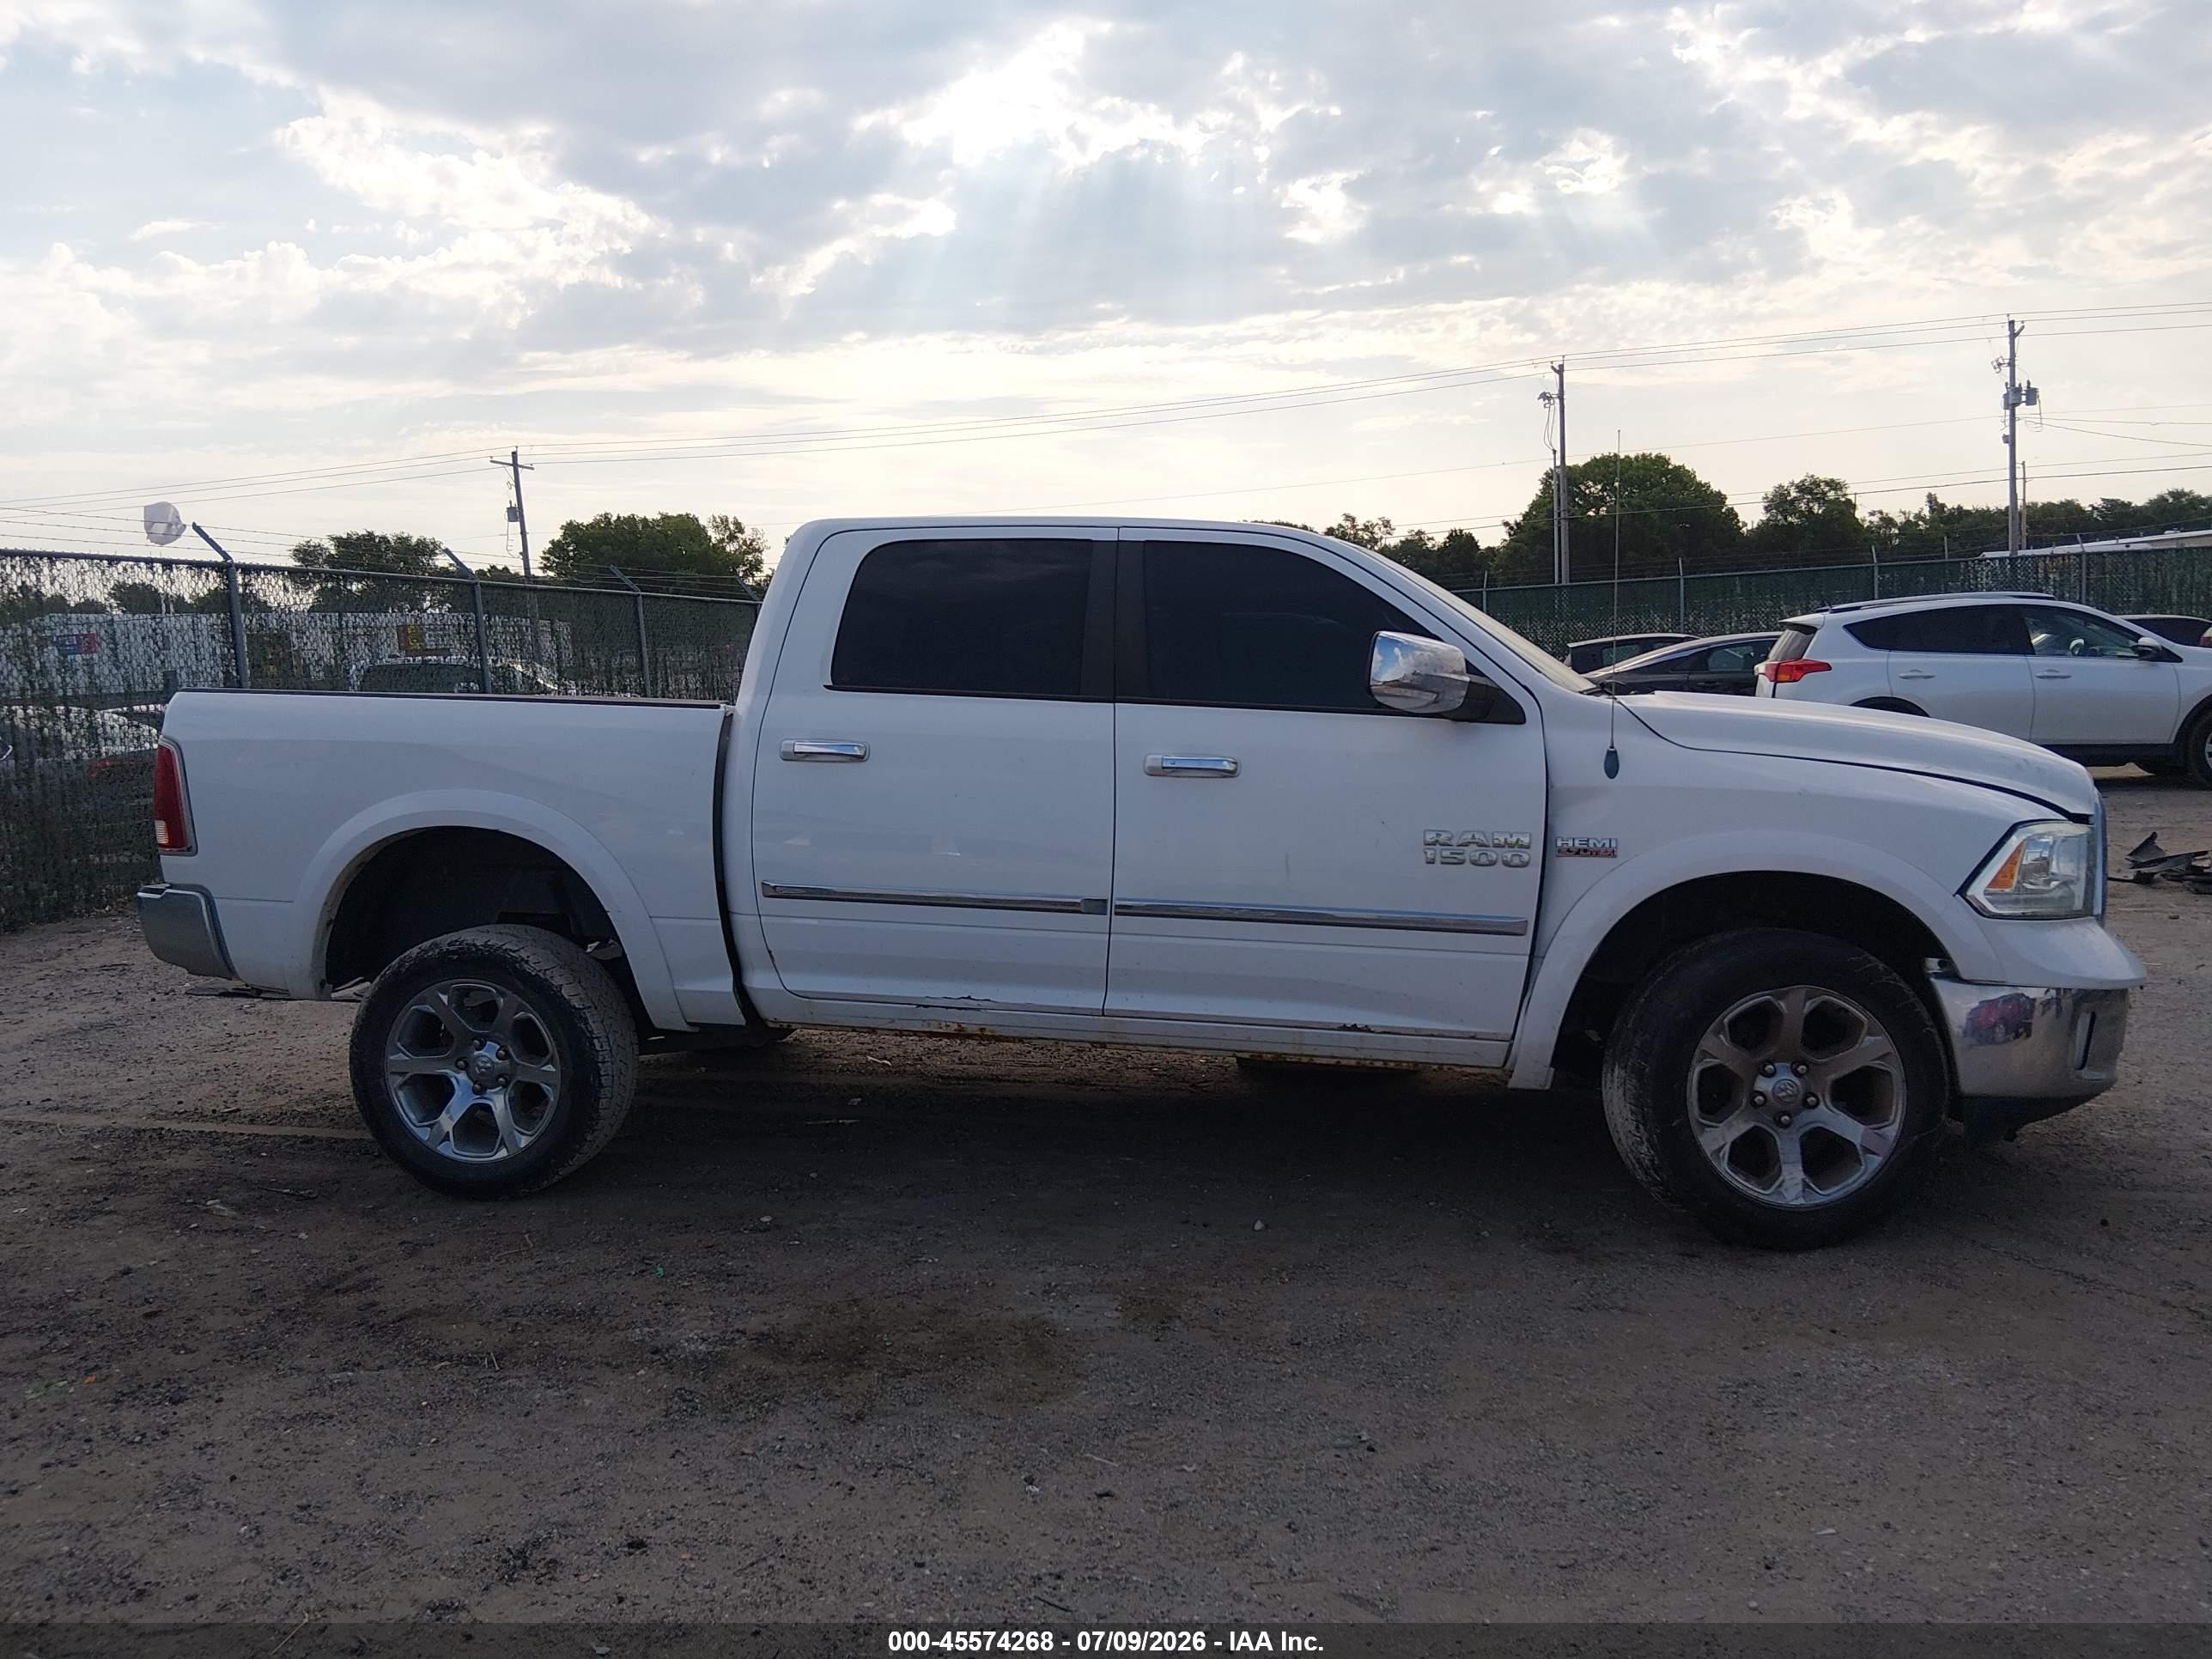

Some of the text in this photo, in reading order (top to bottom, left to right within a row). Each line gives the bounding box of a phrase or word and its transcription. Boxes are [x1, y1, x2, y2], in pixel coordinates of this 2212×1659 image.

[1424, 830, 1531, 848] RAM
[1556, 838, 1616, 848] HEMI
[1424, 848, 1530, 867] 1500
